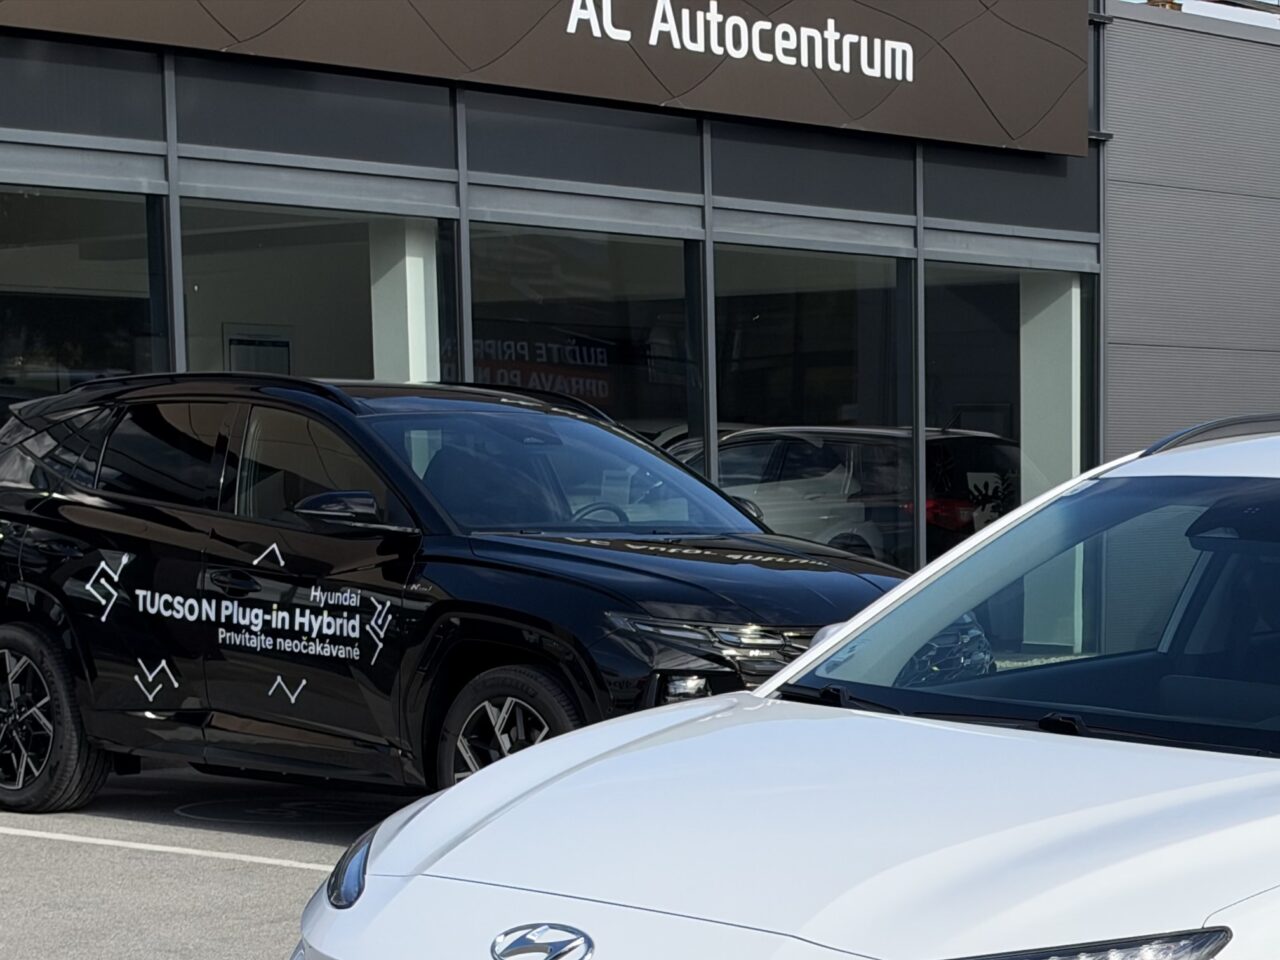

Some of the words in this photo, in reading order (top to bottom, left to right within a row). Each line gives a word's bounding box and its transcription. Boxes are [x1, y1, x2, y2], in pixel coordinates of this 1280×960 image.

[566, 0, 631, 41] AC
[648, 0, 914, 82] Autocentrum
[135, 589, 216, 622] TUCSON
[221, 600, 290, 632] Plug-in
[294, 608, 360, 638] Hybrid
[309, 585, 360, 608] Hyundai
[218, 627, 274, 652] Privítajte
[276, 632, 361, 661] neočakávané
